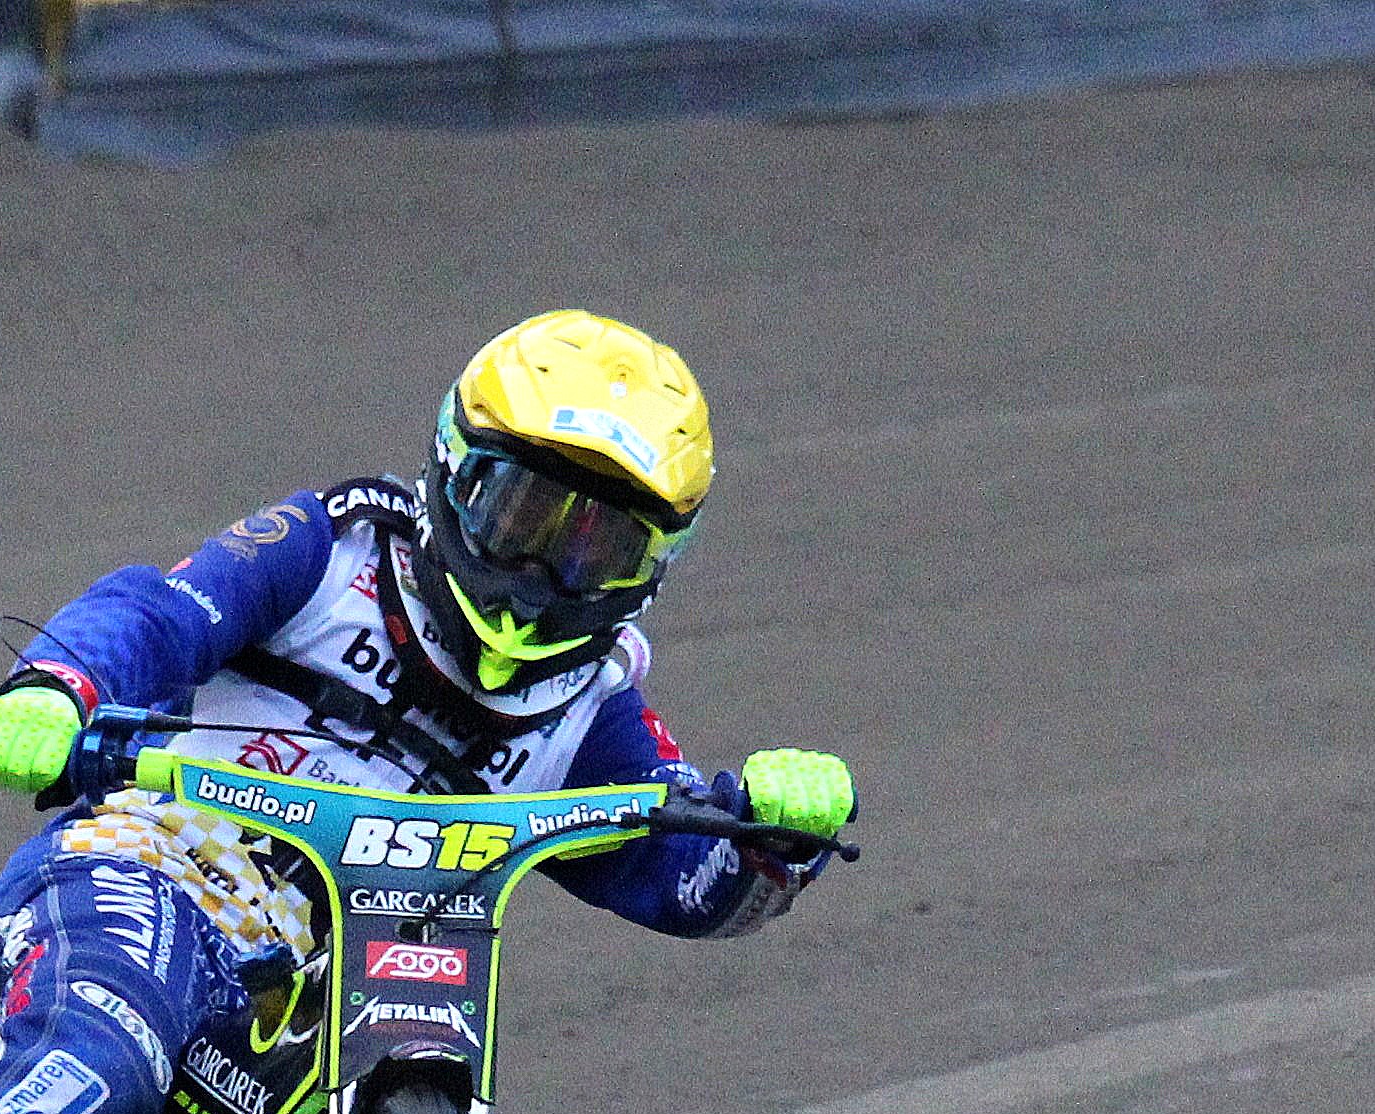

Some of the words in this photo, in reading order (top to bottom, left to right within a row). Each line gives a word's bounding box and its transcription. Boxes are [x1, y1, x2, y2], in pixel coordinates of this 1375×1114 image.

[198, 773, 317, 825] budio.pl
[340, 816, 517, 872] BS15
[369, 944, 464, 979] Fogo
[342, 996, 481, 1047] METALIKA
